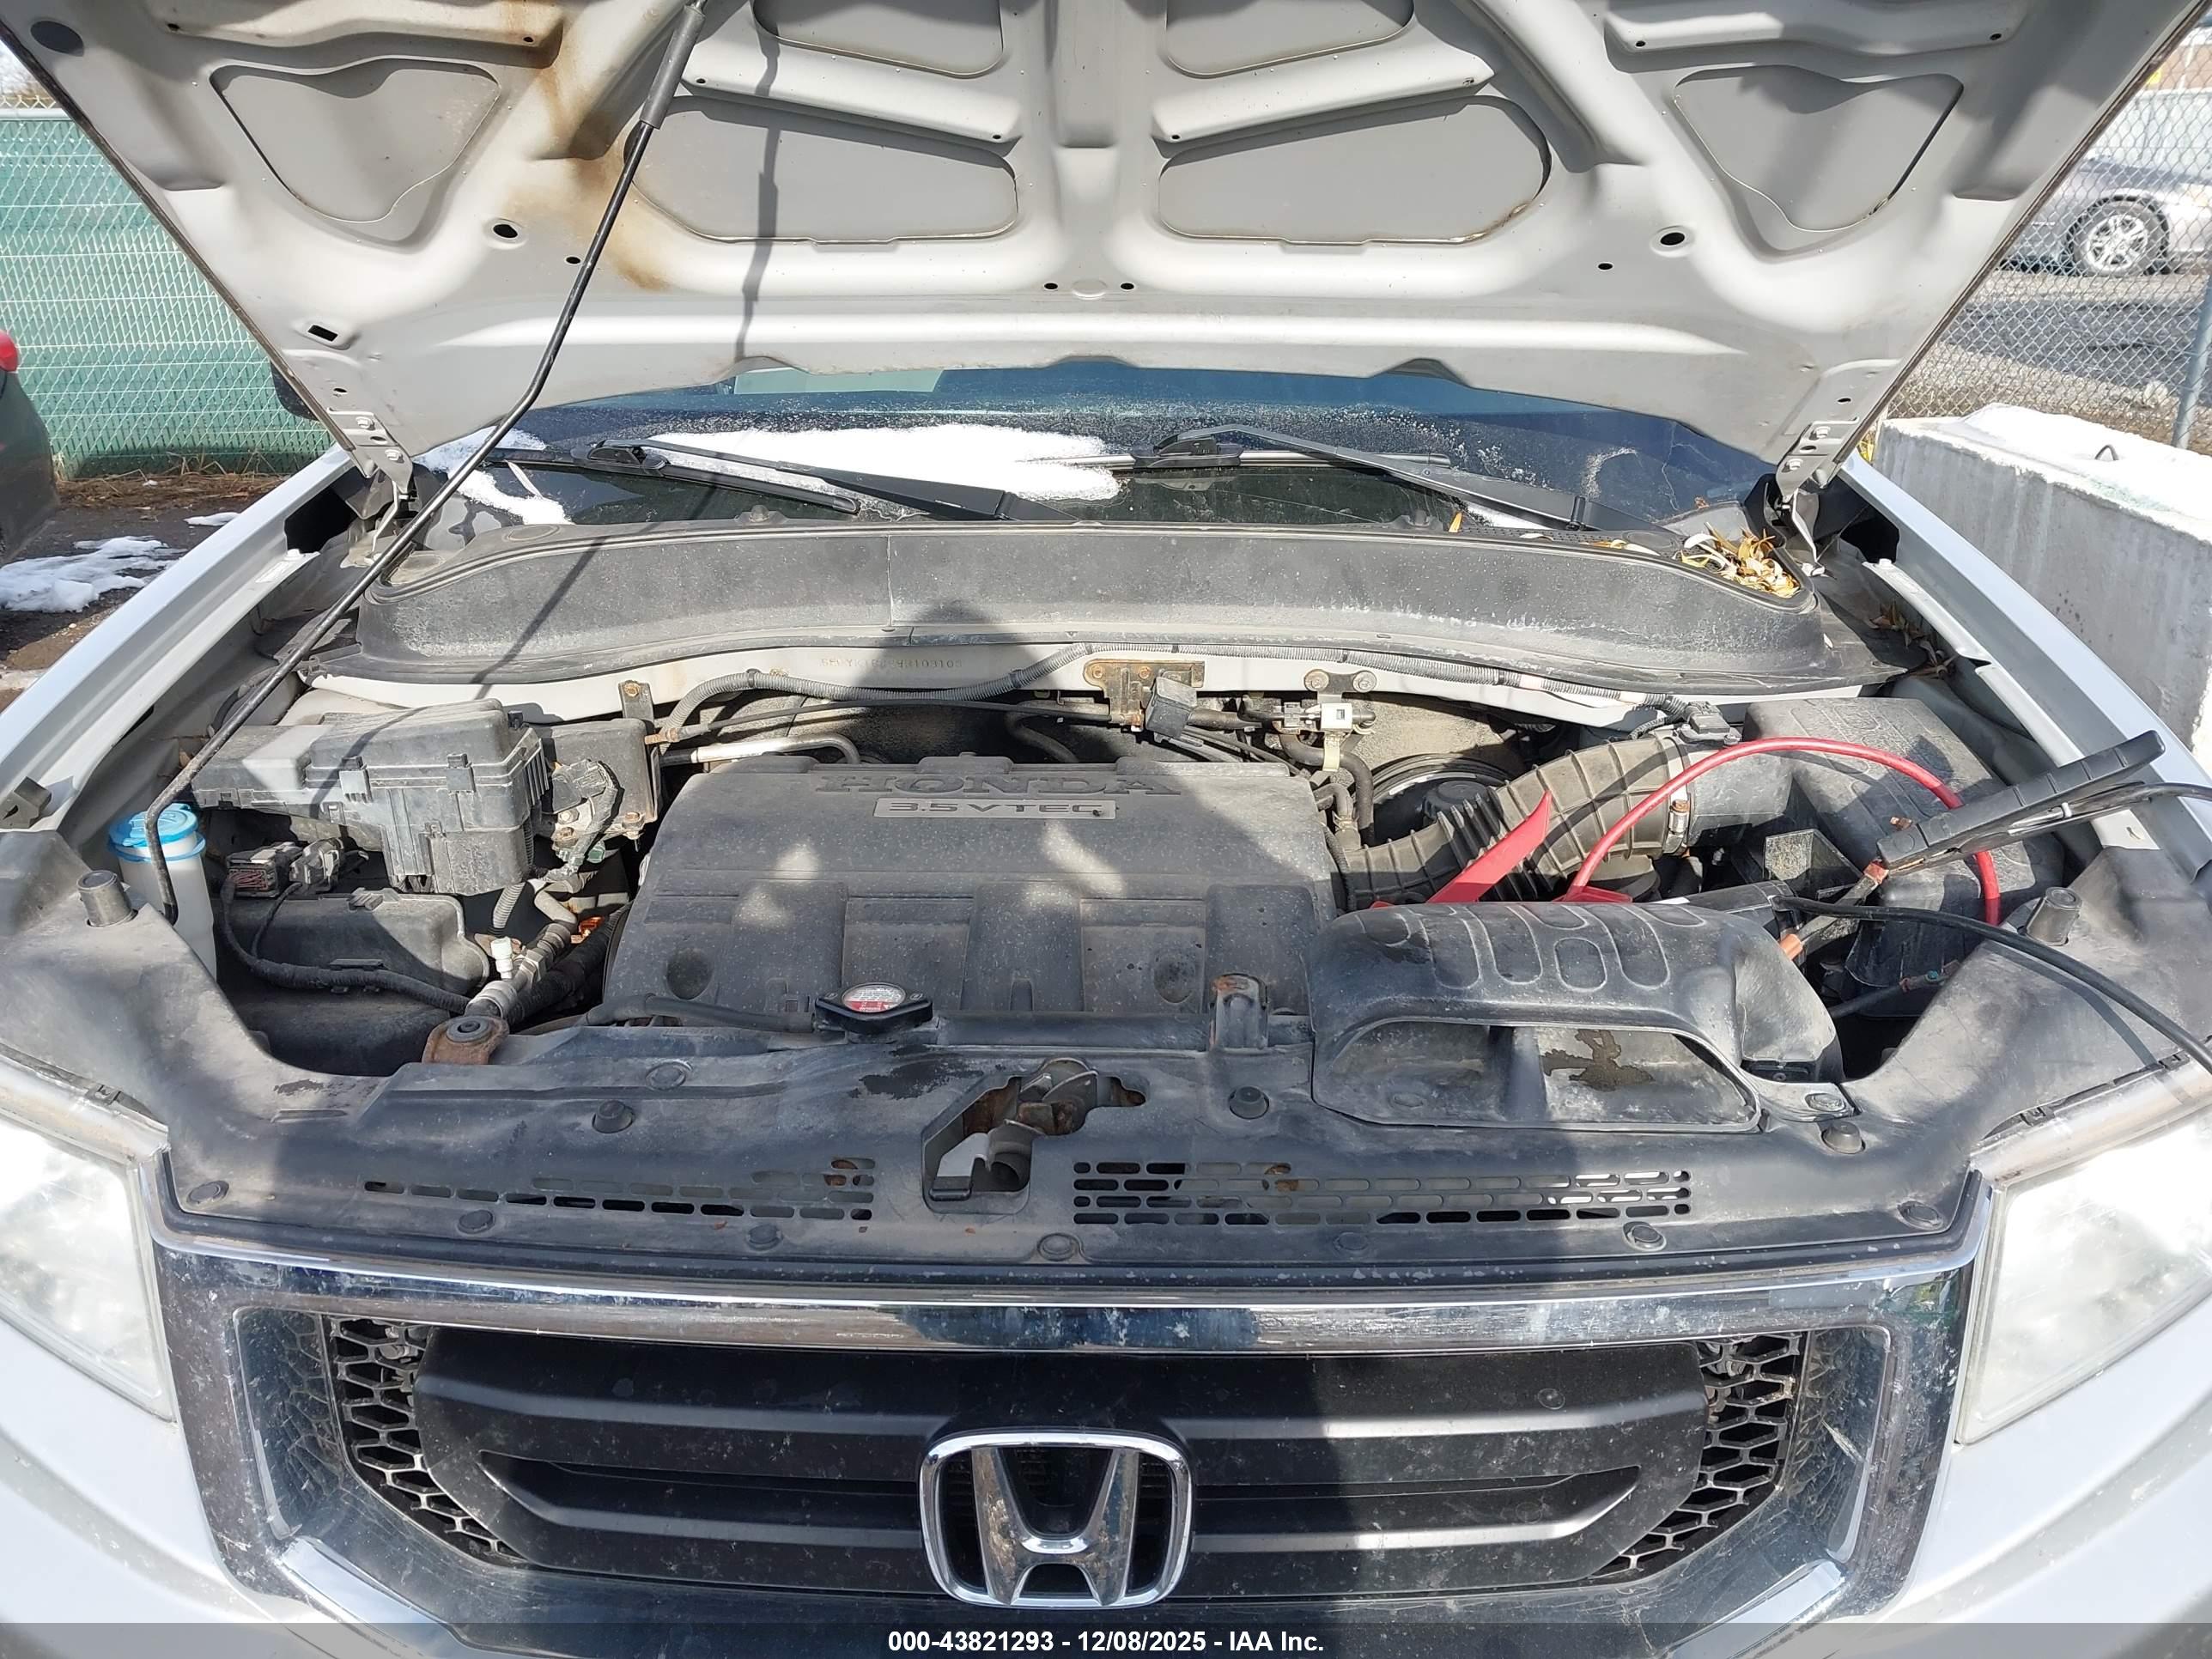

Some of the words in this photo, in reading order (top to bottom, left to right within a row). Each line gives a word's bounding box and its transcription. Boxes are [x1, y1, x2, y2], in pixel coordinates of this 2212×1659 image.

[816, 775, 1182, 796] HONDA
[889, 802, 959, 812] 3.5
[967, 803, 1103, 814] VTEC
